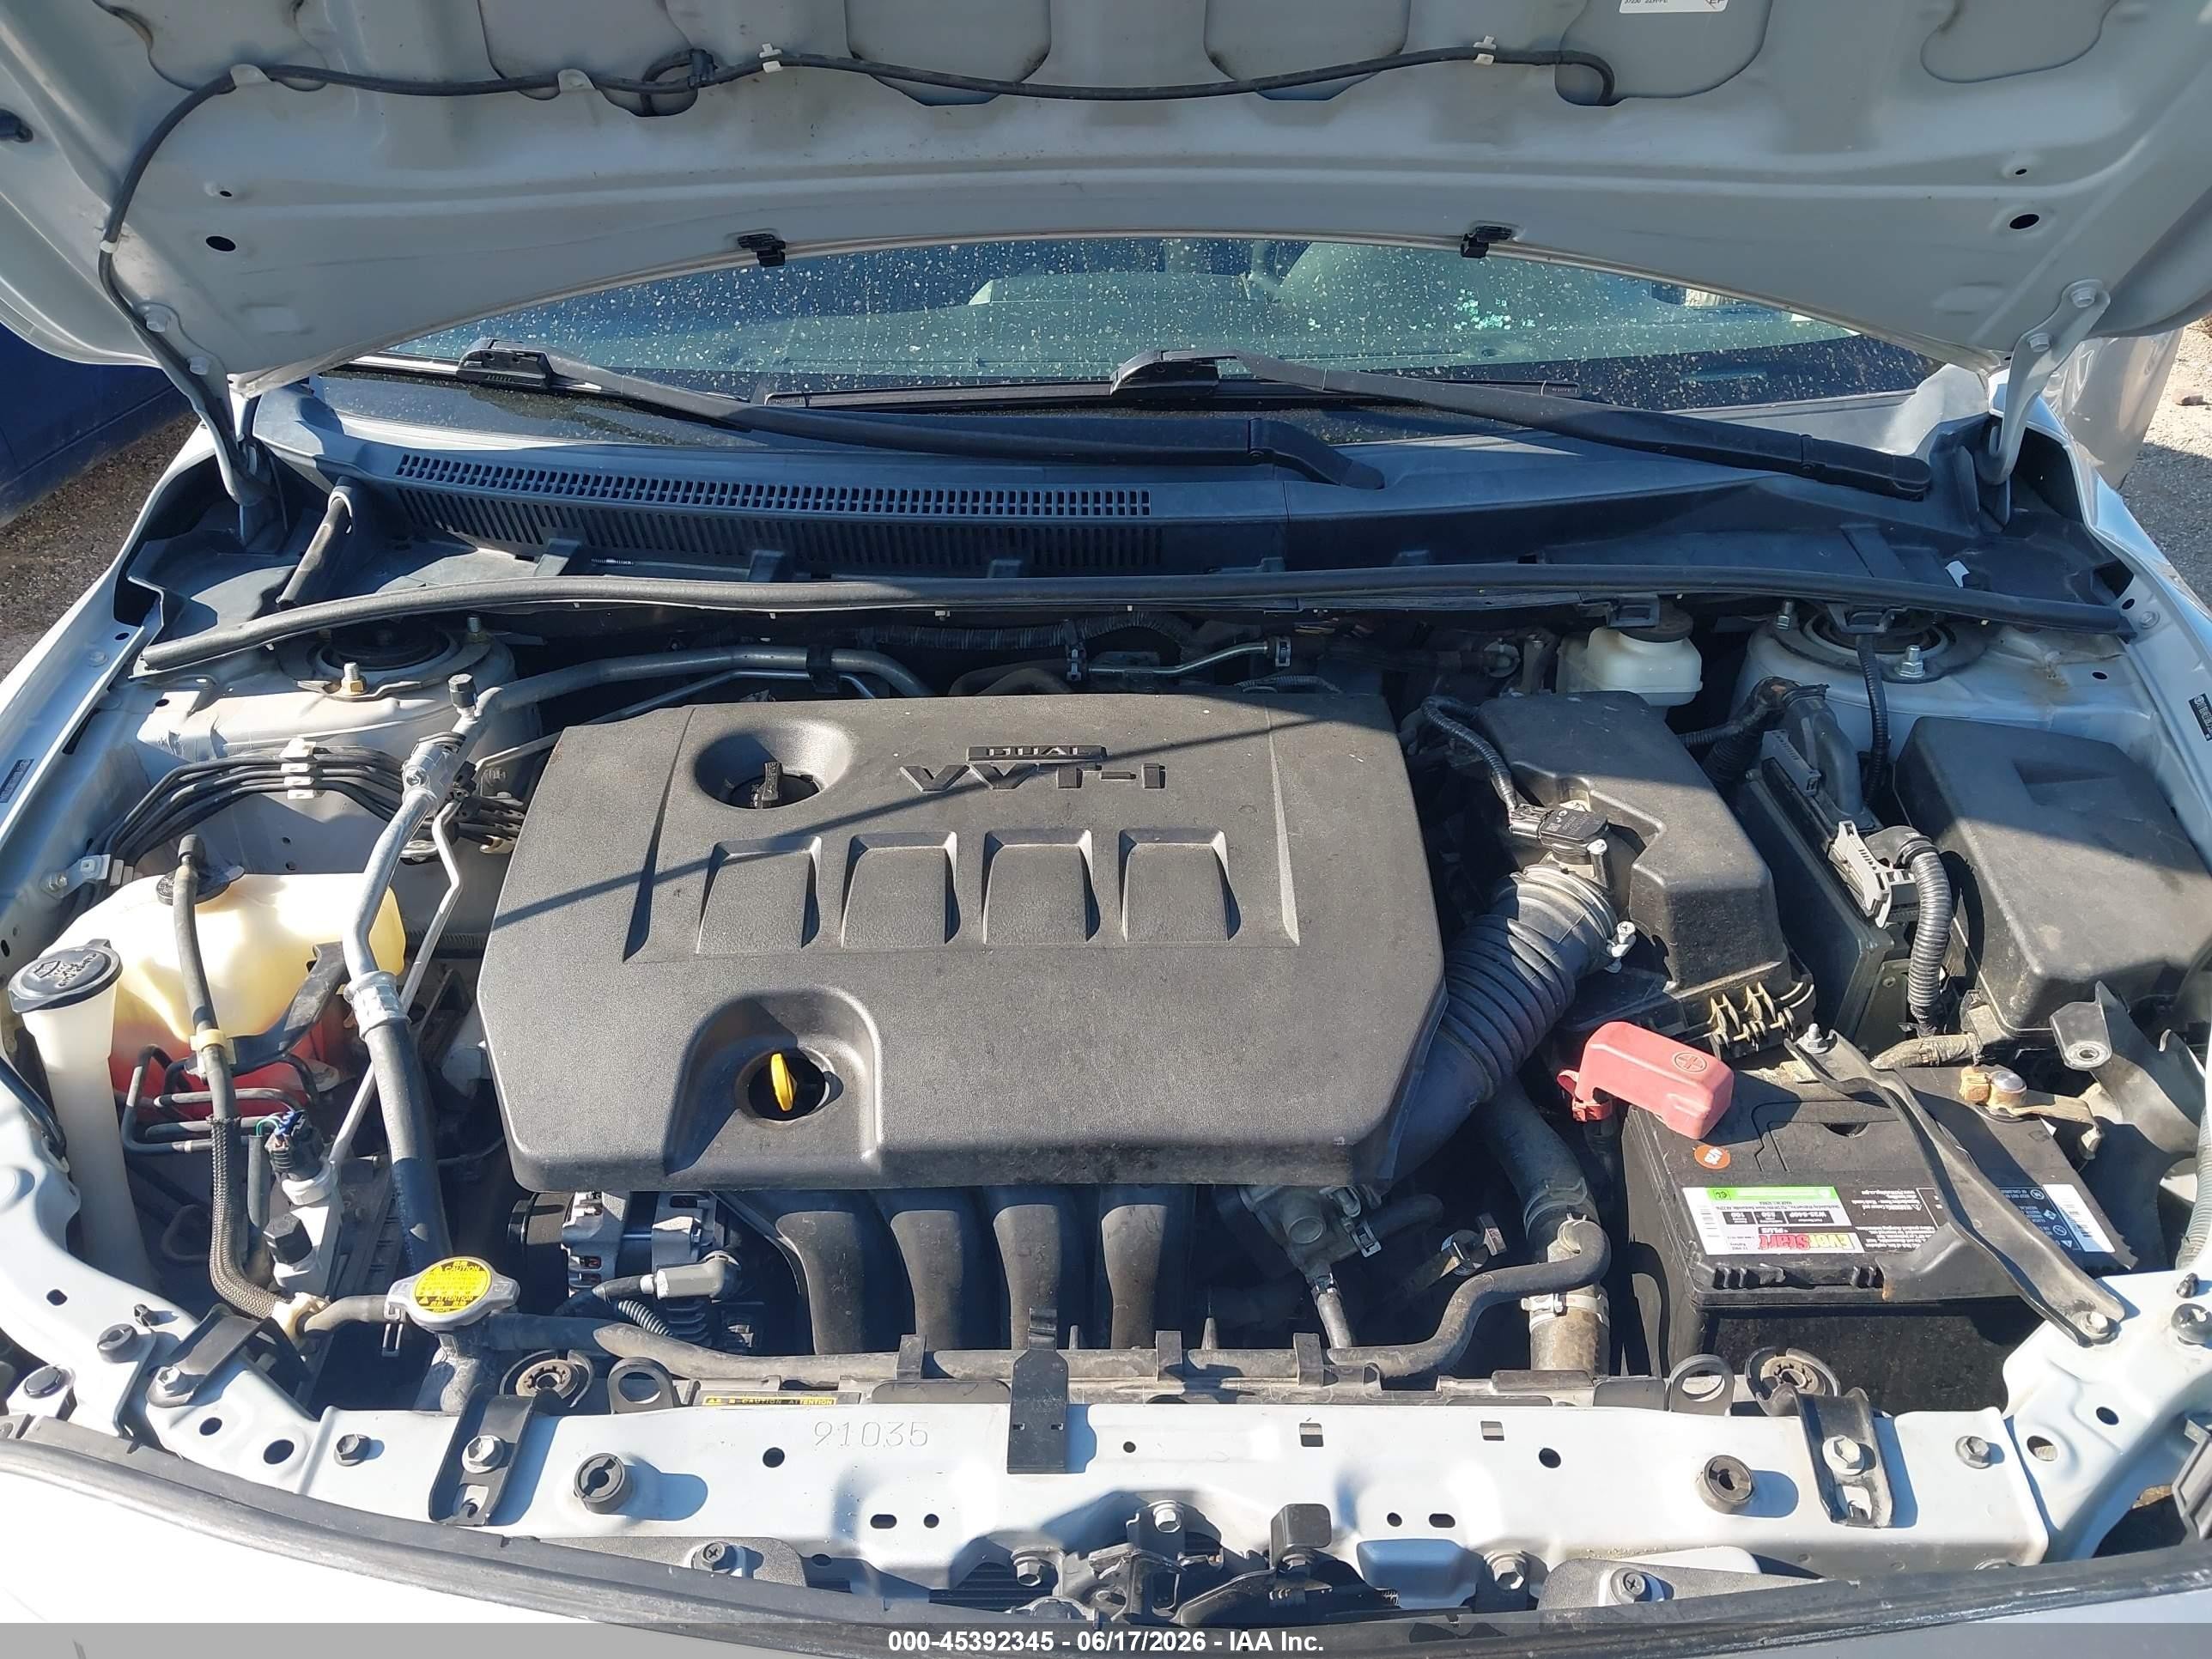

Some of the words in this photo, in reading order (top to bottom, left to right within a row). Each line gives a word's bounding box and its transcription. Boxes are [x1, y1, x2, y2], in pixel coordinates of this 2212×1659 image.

[988, 745, 1089, 757] DUAL
[1760, 1234, 1855, 1250] EverStart
[814, 1421, 928, 1447] 91035
